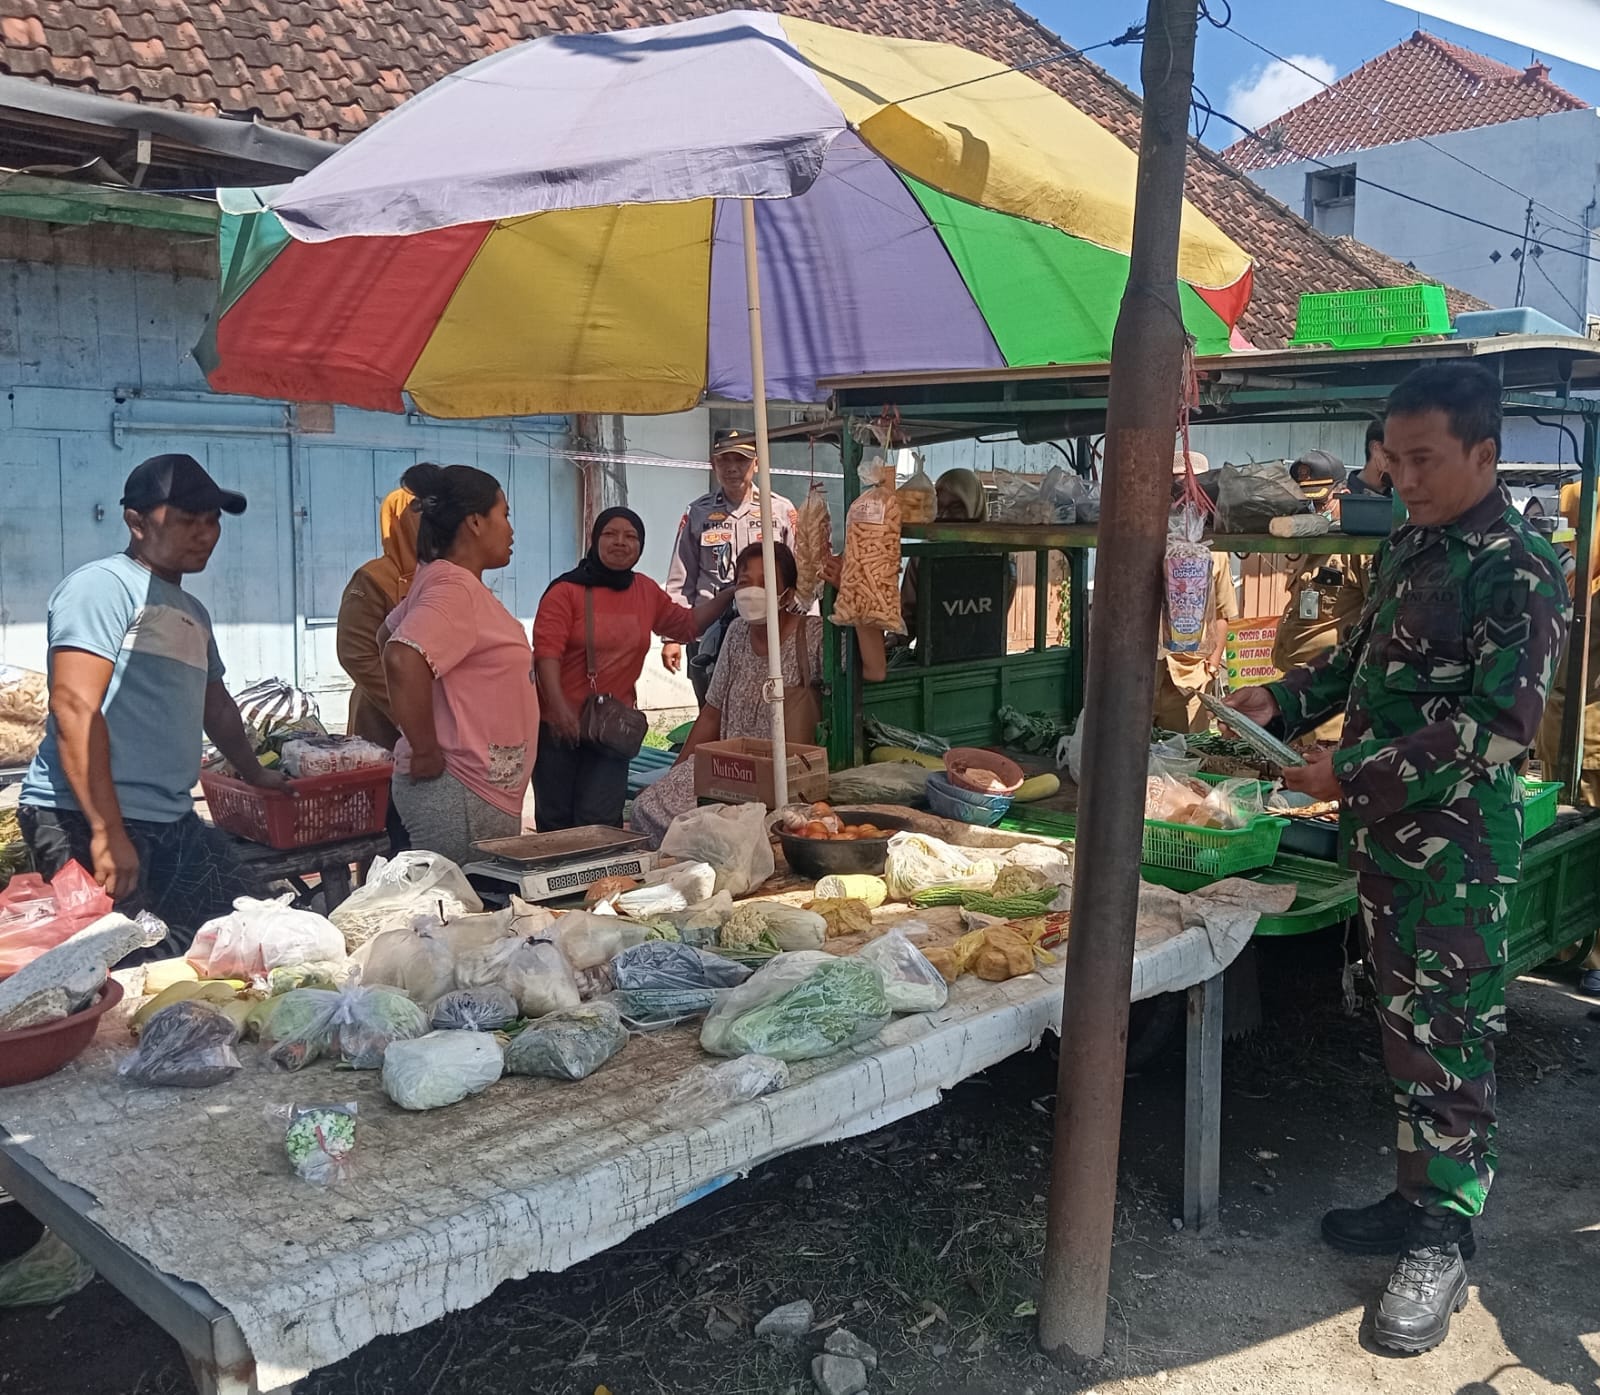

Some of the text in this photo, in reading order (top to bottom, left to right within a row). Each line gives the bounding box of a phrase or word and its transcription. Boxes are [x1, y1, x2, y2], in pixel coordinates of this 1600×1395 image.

[749, 520, 778, 529] POI
[942, 597, 992, 616] VIAR
[1239, 630, 1260, 641] SOSIS
[1240, 648, 1270, 659] HOTANG
